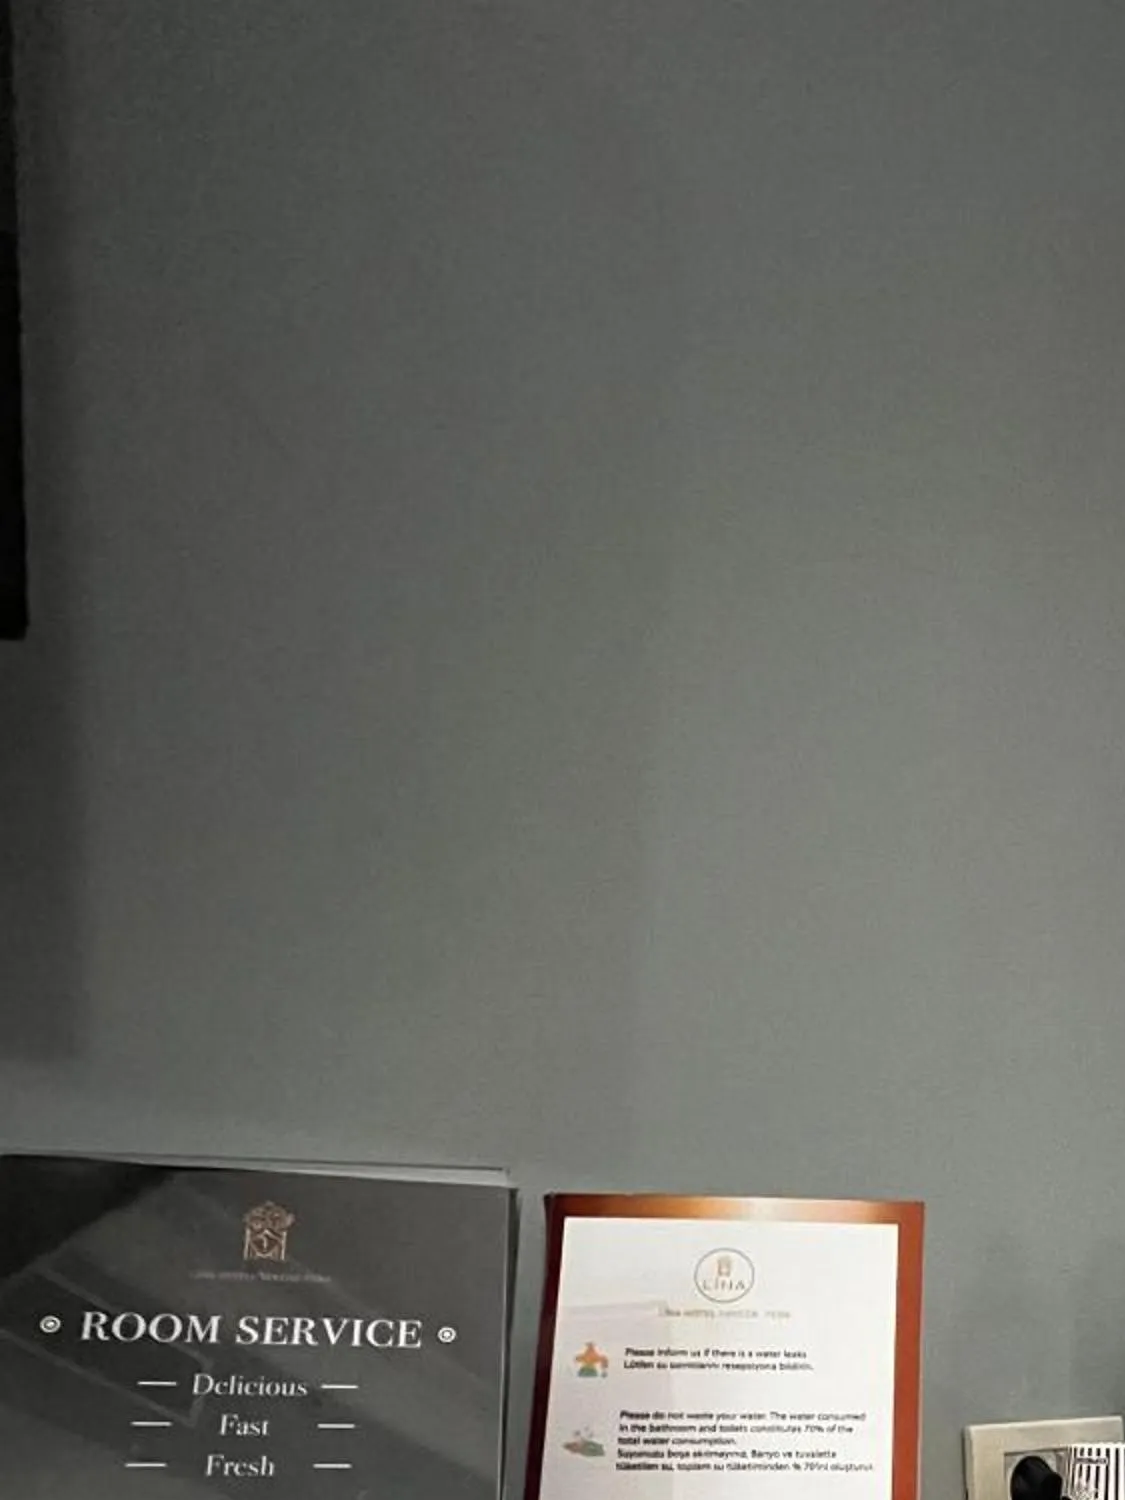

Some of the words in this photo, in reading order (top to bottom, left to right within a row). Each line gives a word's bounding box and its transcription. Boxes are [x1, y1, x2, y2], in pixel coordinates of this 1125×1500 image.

[80, 1311, 222, 1345] ROOM
[234, 1315, 423, 1349] SERVICE
[625, 1347, 655, 1358] Please
[657, 1347, 688, 1357] inform
[690, 1349, 701, 1358] us
[712, 1347, 736, 1358] there
[756, 1349, 781, 1359] water
[192, 1373, 309, 1397] Delicious
[620, 1409, 650, 1421] Please
[652, 1409, 665, 1420] do
[667, 1411, 685, 1420] not
[715, 1412, 737, 1424] your
[769, 1410, 787, 1421] The
[789, 1412, 816, 1421] water
[817, 1411, 867, 1422] consumed
[219, 1413, 270, 1437] Fast
[630, 1423, 647, 1433] the
[649, 1423, 697, 1433] bathroom
[699, 1423, 717, 1433] and
[826, 1423, 837, 1434] of
[838, 1424, 854, 1433] the
[617, 1437, 641, 1446] total
[642, 1437, 670, 1446] water
[751, 1448, 780, 1461] Banyo
[782, 1450, 793, 1459] ve
[205, 1454, 276, 1478] Fresh
[713, 1462, 725, 1472] su
